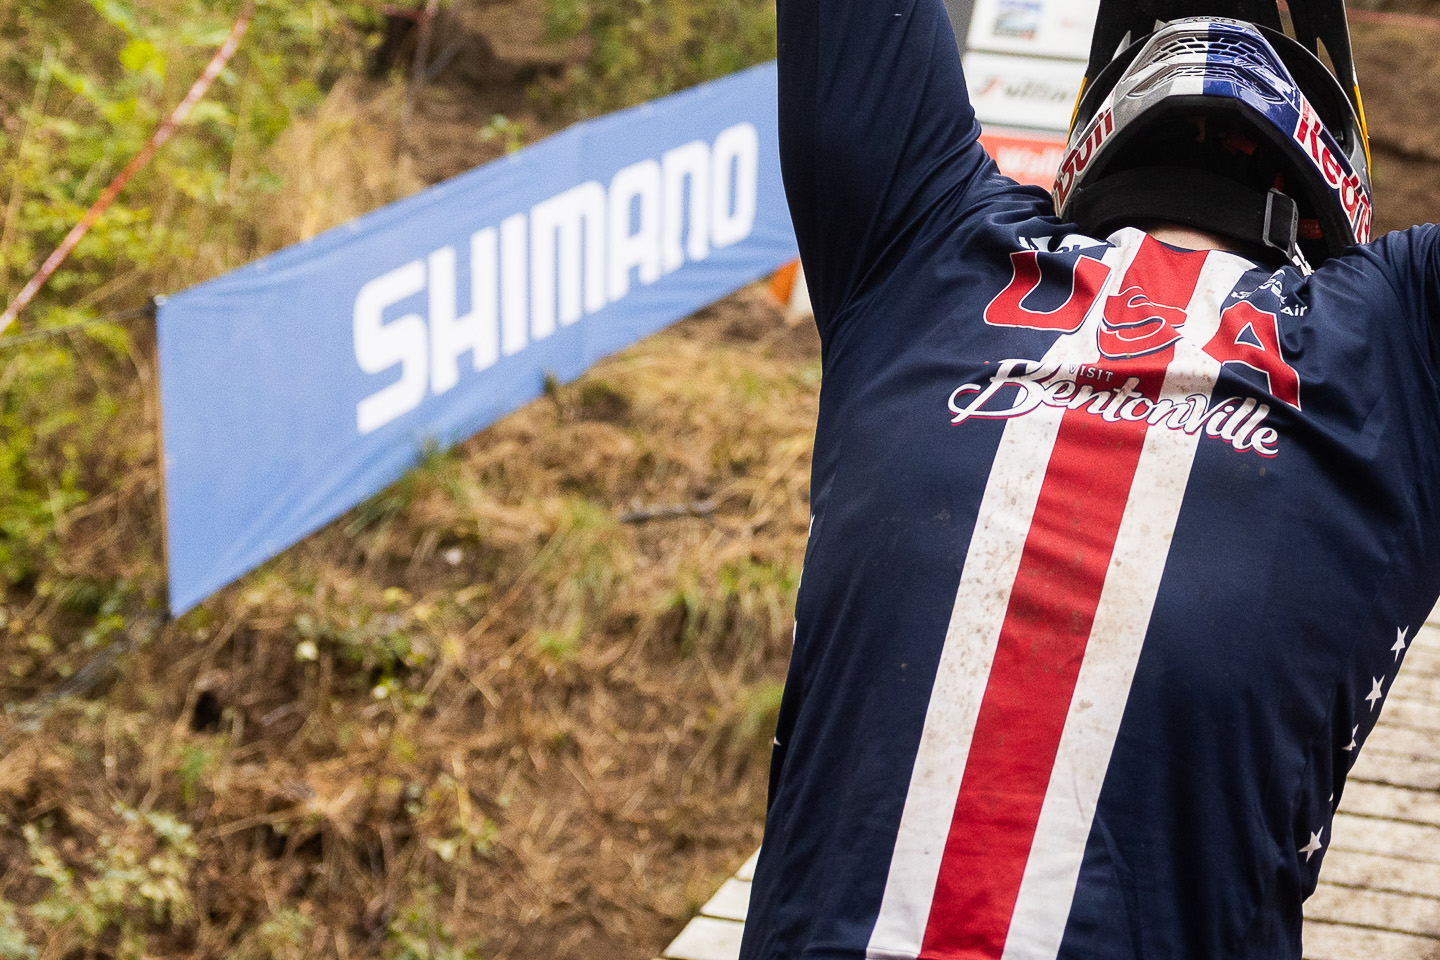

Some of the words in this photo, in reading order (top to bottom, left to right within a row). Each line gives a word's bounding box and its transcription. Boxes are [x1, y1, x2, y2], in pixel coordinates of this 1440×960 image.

[353, 122, 758, 435] SHIMANO
[1280, 303, 1308, 317] Air
[984, 250, 1303, 413] USA
[1069, 362, 1114, 382] VISIT
[947, 357, 1280, 459] Bentonville
